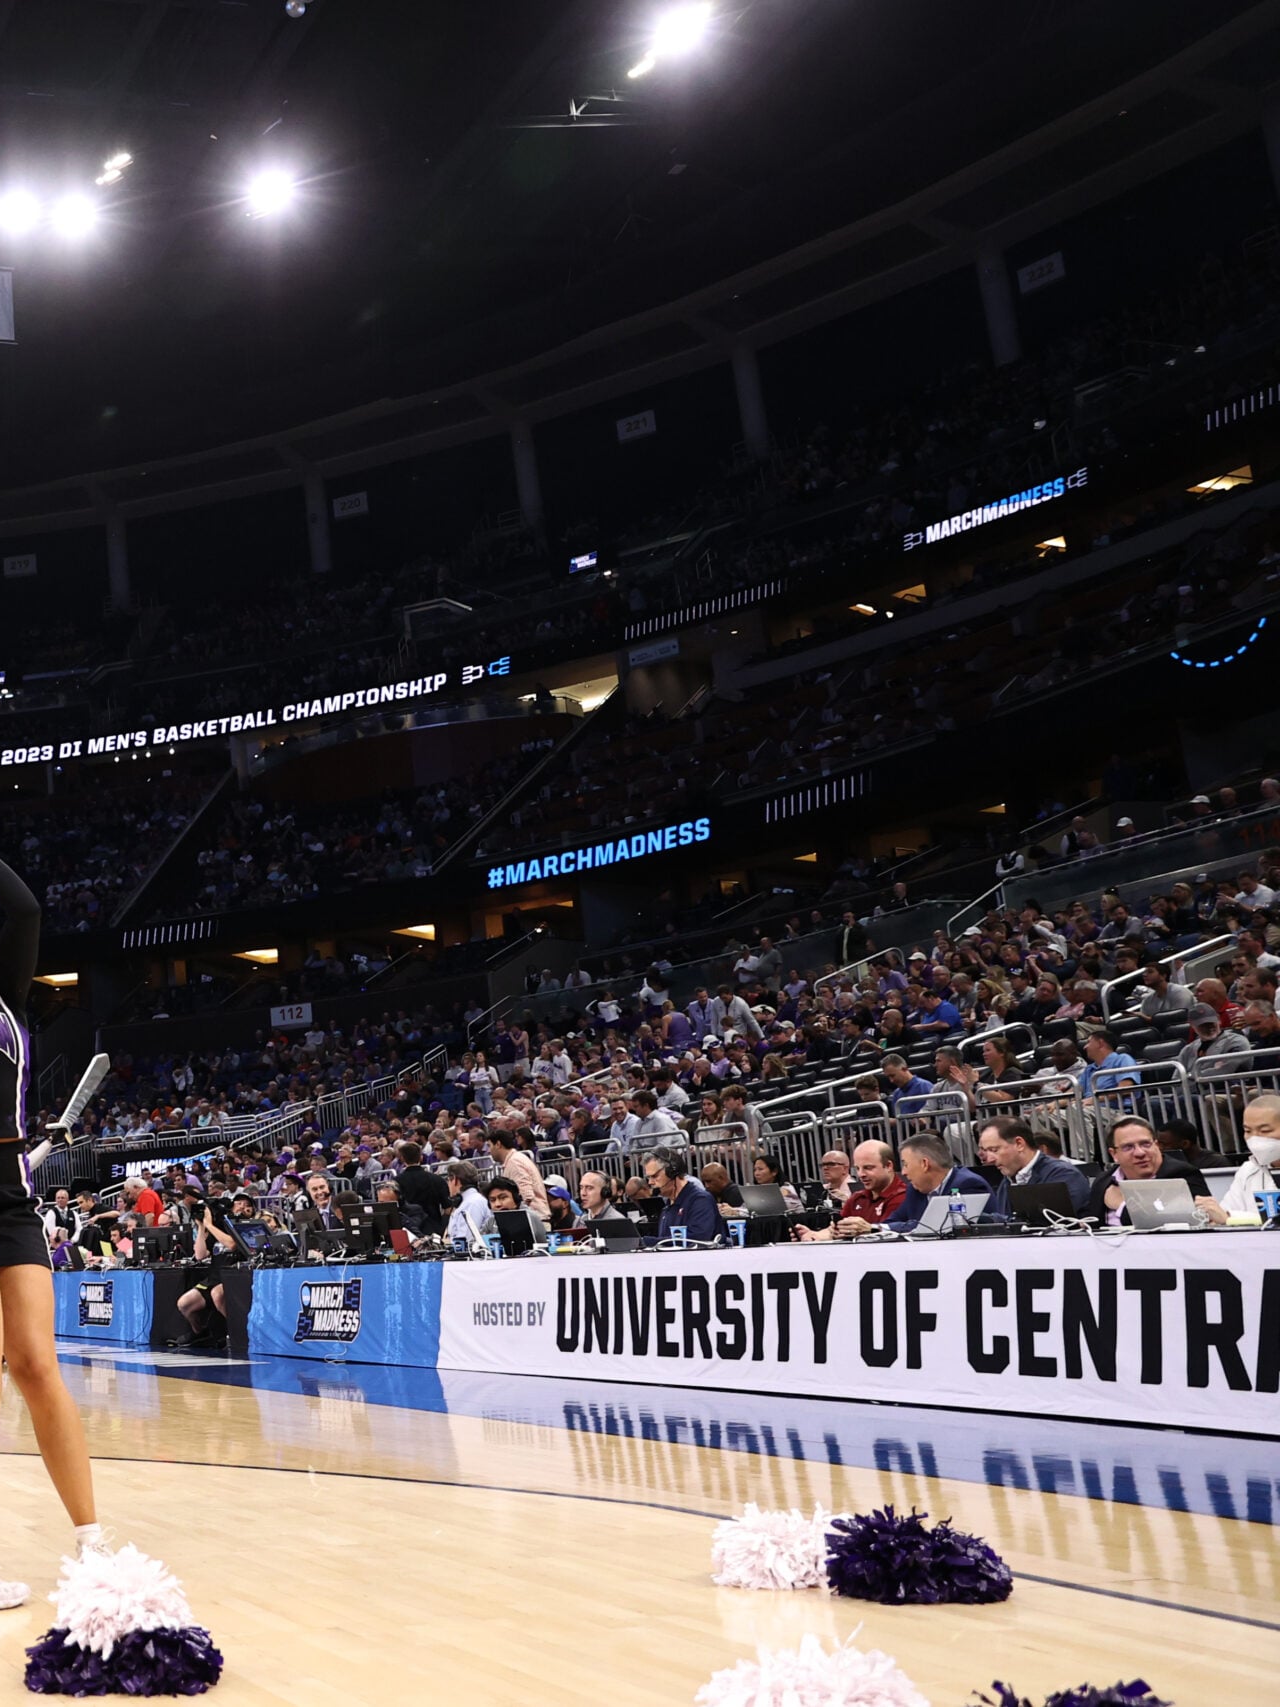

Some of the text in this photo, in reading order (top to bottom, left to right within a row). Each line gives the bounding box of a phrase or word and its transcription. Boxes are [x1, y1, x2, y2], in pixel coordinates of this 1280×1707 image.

[625, 417, 648, 433] 221
[339, 498, 361, 512] 220
[925, 476, 1066, 545] MARCHMADNESS
[0, 673, 448, 766] 2023 DI MEN'S BASKETBALL CHAMPIONSHIP
[487, 817, 710, 889] #MARCHMADNESS
[279, 1007, 303, 1021] 112
[310, 1286, 344, 1308] MARCH
[312, 1309, 360, 1332] MADNESS
[473, 1301, 523, 1327] HOSTED
[526, 1301, 546, 1327] BY
[556, 1271, 838, 1364] UNIVERSITY
[859, 1270, 939, 1369] OF
